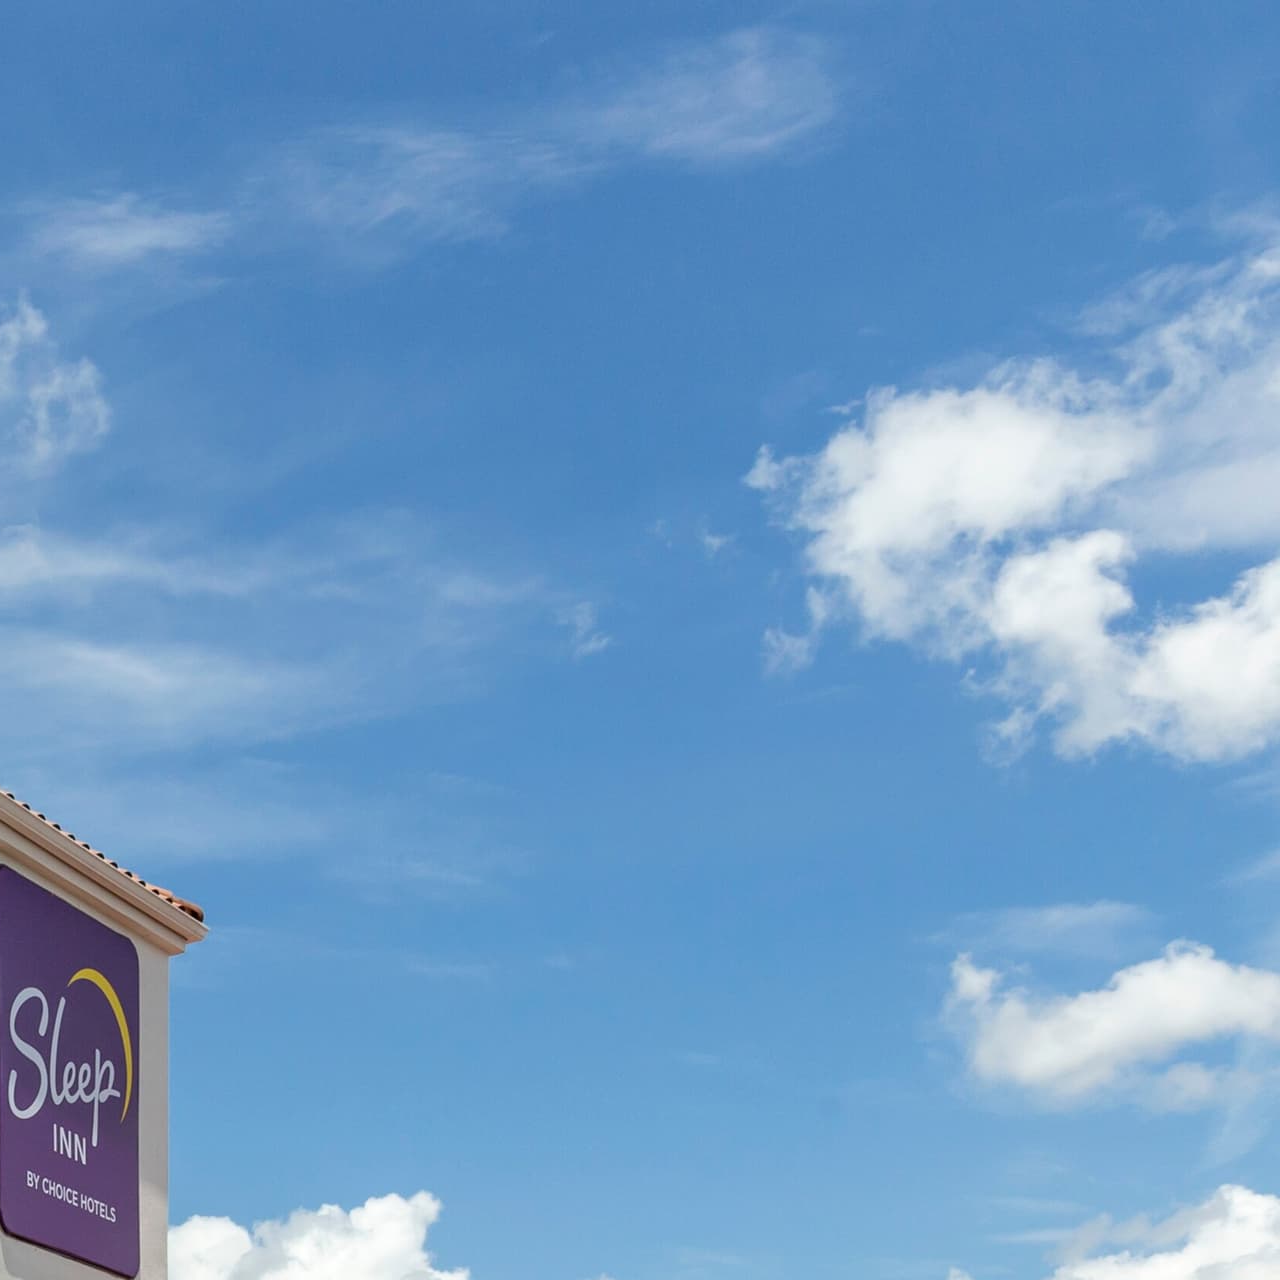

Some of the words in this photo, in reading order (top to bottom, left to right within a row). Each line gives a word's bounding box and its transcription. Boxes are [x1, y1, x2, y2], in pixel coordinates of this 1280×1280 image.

[6, 986, 121, 1148] Sleep
[53, 1123, 87, 1166] INN
[26, 1170, 41, 1191] BY
[41, 1177, 79, 1208] CHOICE
[80, 1193, 117, 1224] HOTELS
